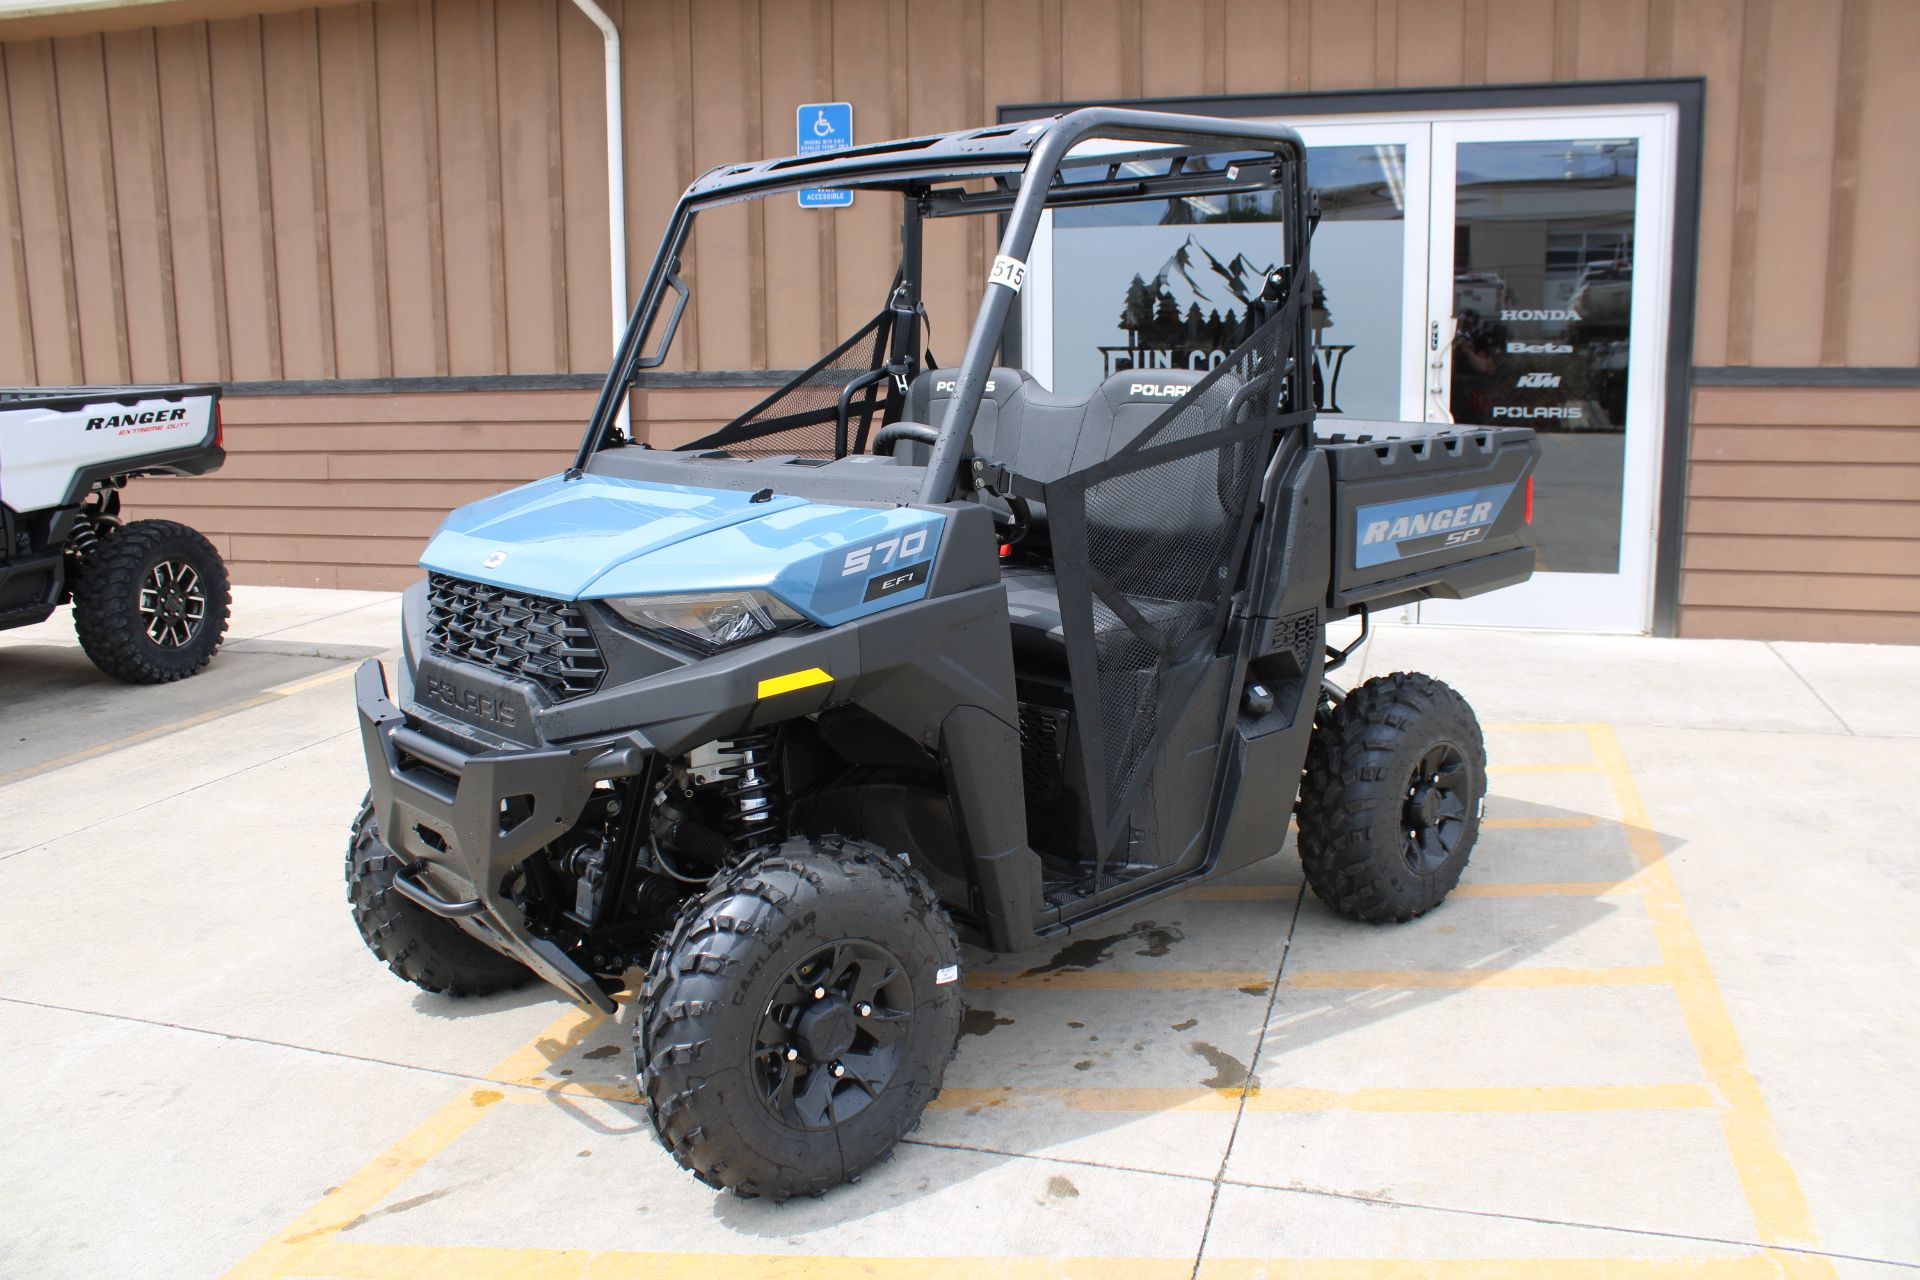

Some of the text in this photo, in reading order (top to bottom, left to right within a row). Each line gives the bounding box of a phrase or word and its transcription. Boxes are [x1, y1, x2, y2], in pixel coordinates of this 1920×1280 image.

[806, 192, 845, 201] ACCESSIBLE
[993, 260, 1025, 286] 515
[1501, 310, 1582, 321] HONDA
[1506, 342, 1574, 353] Beta
[1516, 372, 1562, 388] KTM
[1130, 384, 1192, 397] POLAR
[85, 408, 187, 431] RANGER
[1493, 406, 1582, 419] POLARIS
[118, 421, 191, 436] EXTREME DUTY
[1363, 501, 1493, 545] RANGER
[1444, 528, 1481, 546] SP
[881, 572, 914, 590] EFI
[427, 676, 516, 728] POLARIS
